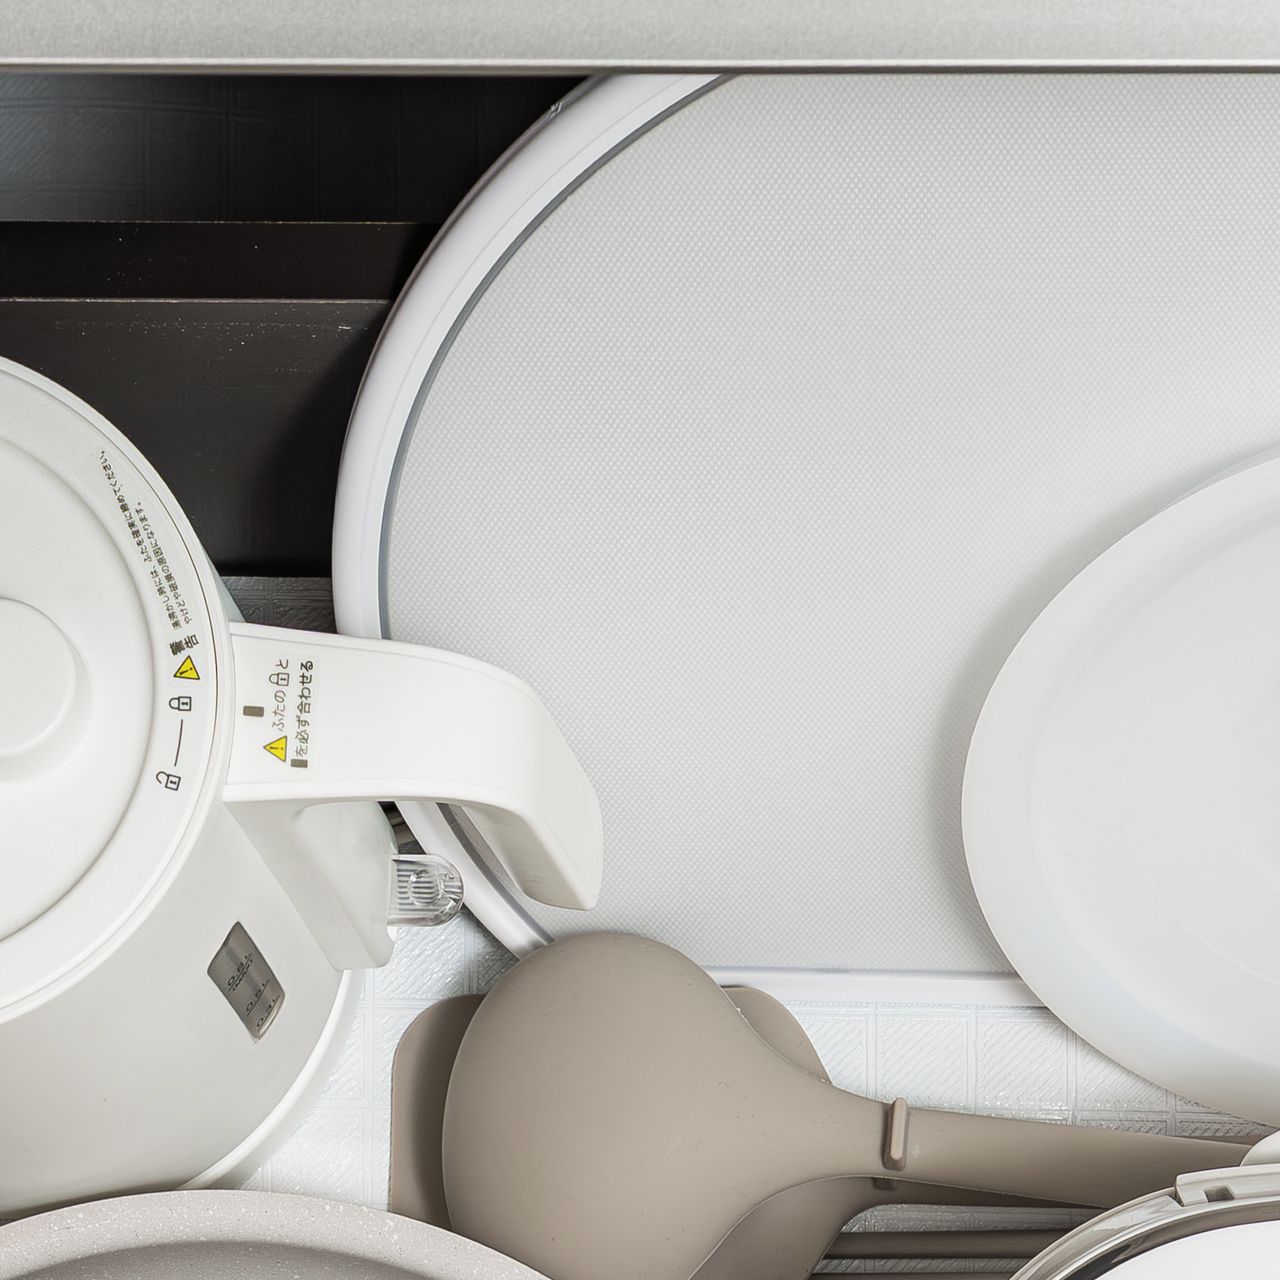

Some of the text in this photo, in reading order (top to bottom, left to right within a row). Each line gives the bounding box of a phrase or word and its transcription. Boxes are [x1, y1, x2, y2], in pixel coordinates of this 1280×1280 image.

[169, 634, 200, 656] 警告
[272, 659, 289, 731] ふたの と
[295, 660, 313, 757] を必ず合わせる
